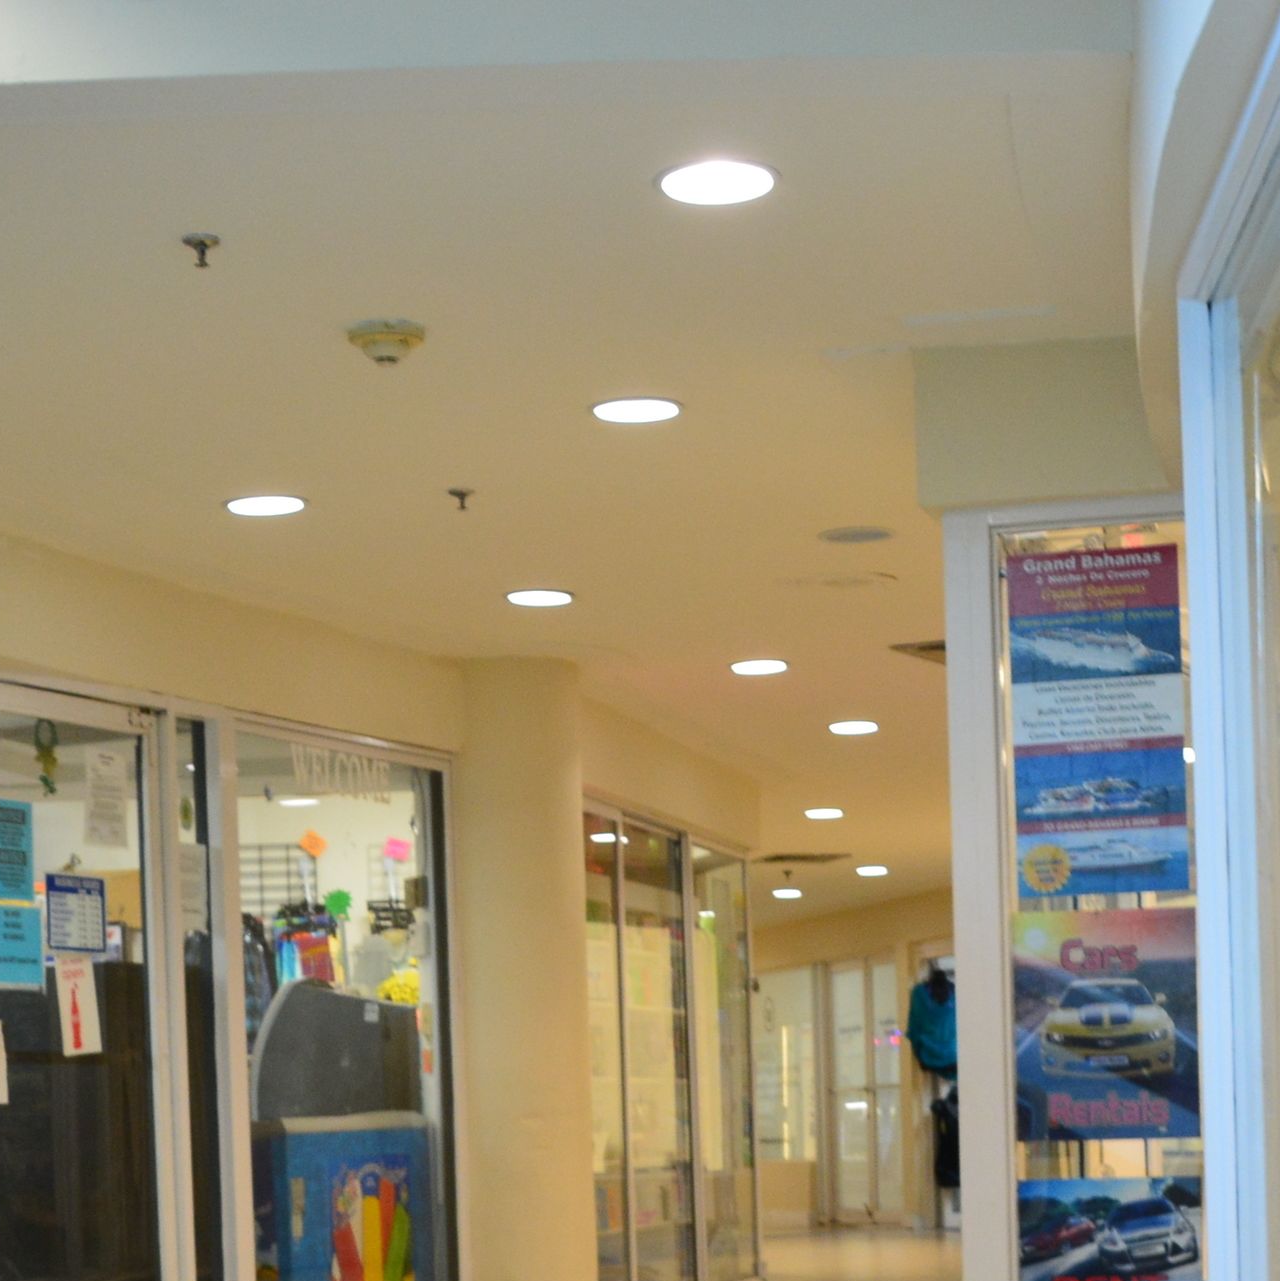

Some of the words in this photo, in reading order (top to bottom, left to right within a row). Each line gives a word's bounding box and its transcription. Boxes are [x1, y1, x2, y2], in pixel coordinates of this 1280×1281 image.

[1023, 555, 1077, 574] Grand
[1081, 550, 1162, 569] Bahamas
[289, 741, 391, 805] WELCOME
[1060, 936, 1139, 972] Cars
[1048, 1089, 1170, 1128] Rentals
